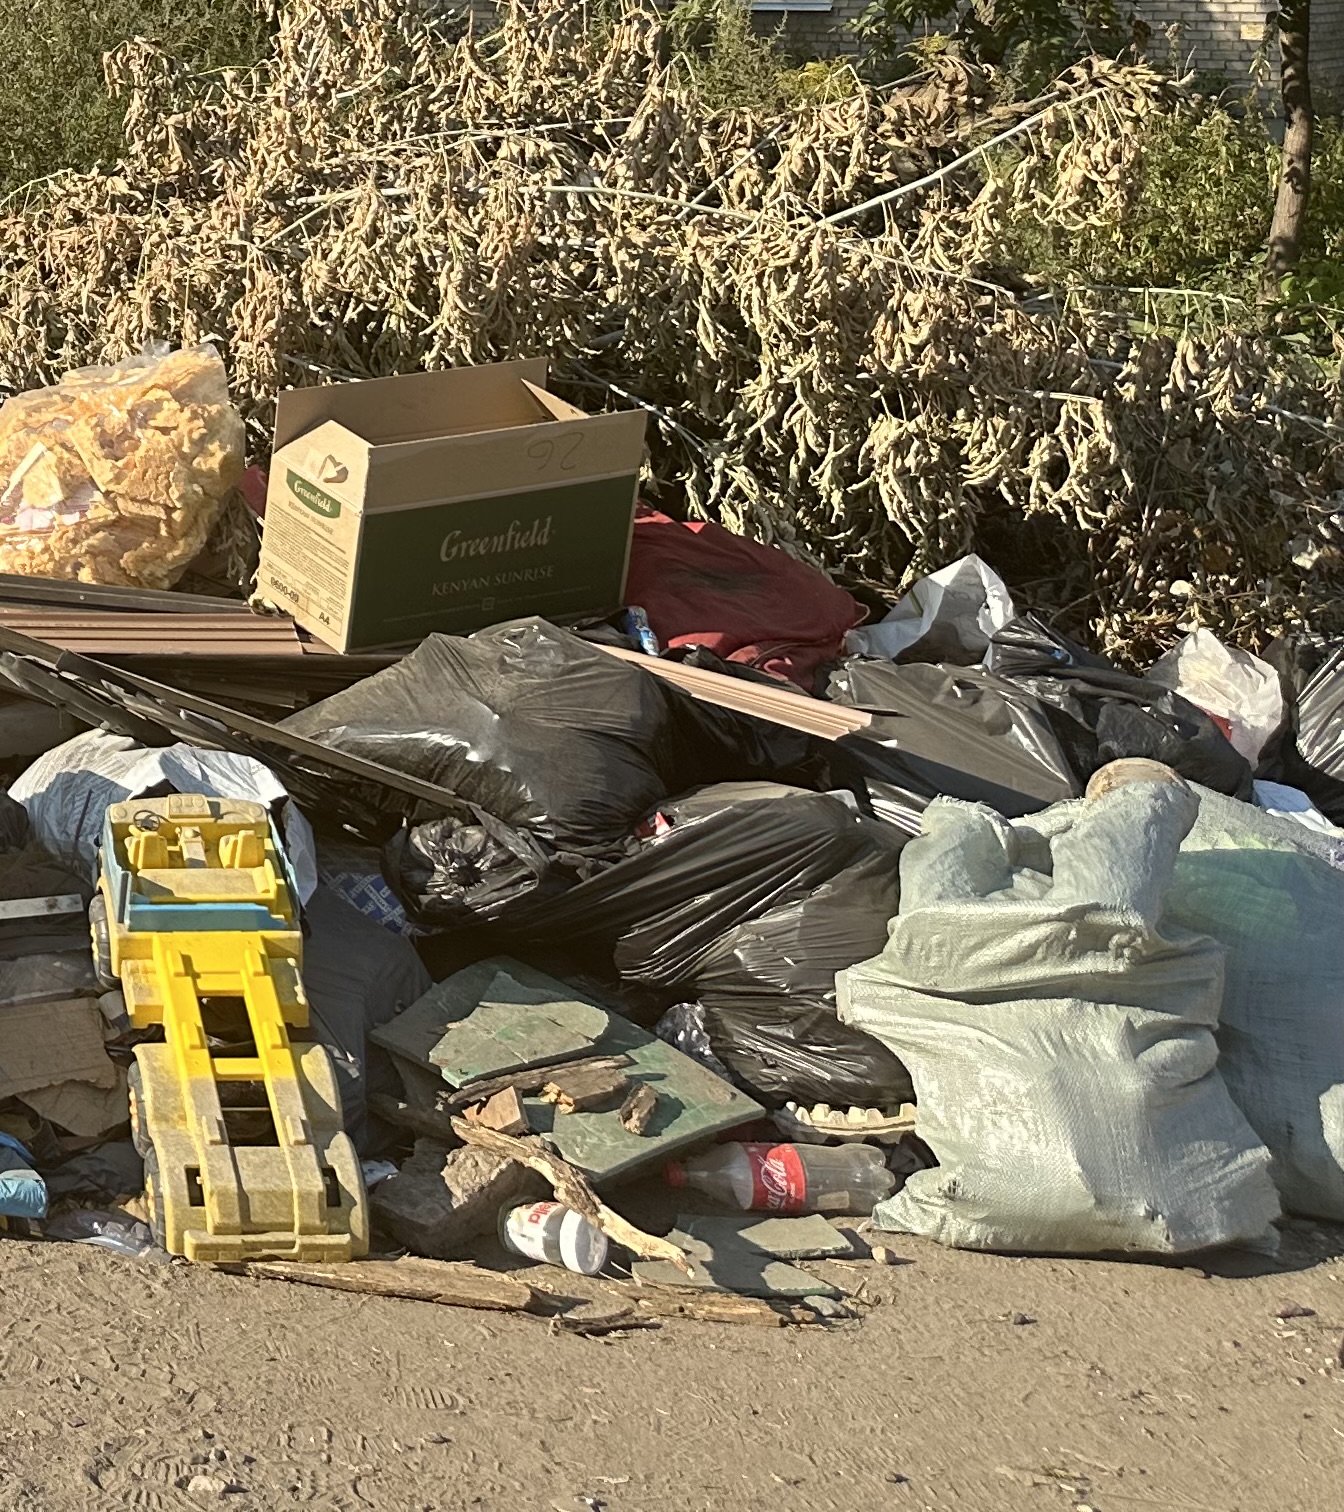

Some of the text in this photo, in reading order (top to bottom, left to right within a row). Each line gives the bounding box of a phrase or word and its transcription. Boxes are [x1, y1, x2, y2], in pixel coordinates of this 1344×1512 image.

[293, 480, 332, 513] Greenfield
[440, 515, 553, 563] Greenfield
[431, 575, 491, 597] KENYAN
[493, 565, 555, 586] SUNRISE
